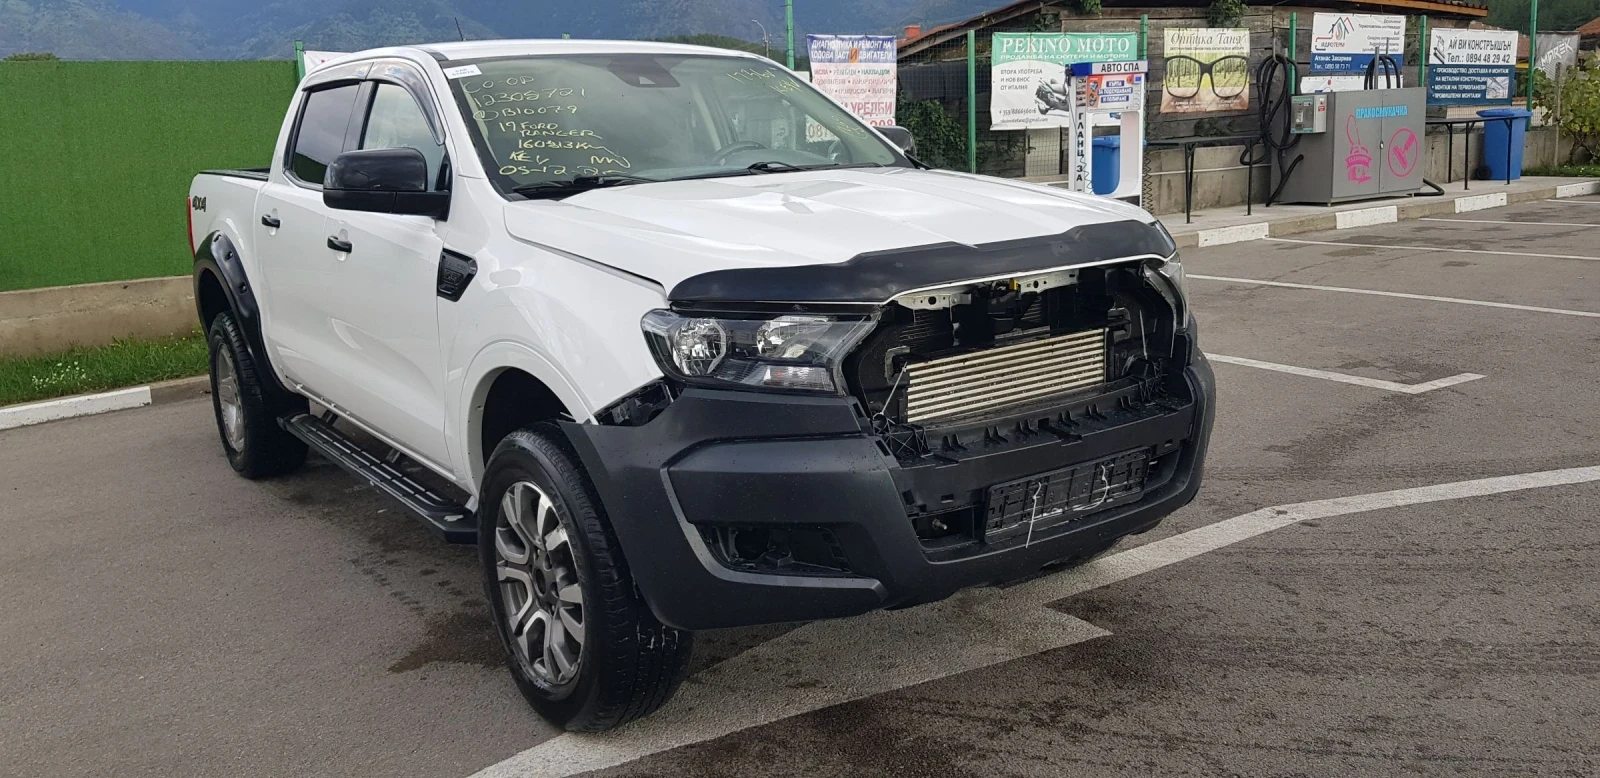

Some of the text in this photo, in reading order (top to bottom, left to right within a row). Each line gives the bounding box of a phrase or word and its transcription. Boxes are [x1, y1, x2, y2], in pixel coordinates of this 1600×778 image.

[859, 40, 882, 48] РЕМОНТ
[883, 40, 891, 48] НА
[1002, 37, 1130, 53] PEKINO MOTO
[1171, 32, 1247, 45] Оптика Таня
[1448, 37, 1511, 51] АЙ ВИ КОНСТРЪКШЪН
[859, 51, 893, 59] ДВИГАТЕЛИ
[1466, 53, 1481, 63] 0894
[1483, 54, 1490, 63] 48
[1492, 54, 1500, 63] 29
[1502, 54, 1510, 63] 42
[1101, 63, 1140, 72] АВТО СПА
[463, 75, 534, 93] CO-OP
[850, 101, 893, 115] УРЕДБИ
[1355, 105, 1408, 119] ПРАХОСМУКАЧКА
[499, 121, 558, 132] 19 FORD
[520, 129, 602, 140] RANGER
[1076, 112, 1084, 158] ГЛАНЦ
[1076, 165, 1083, 181] ЗА
